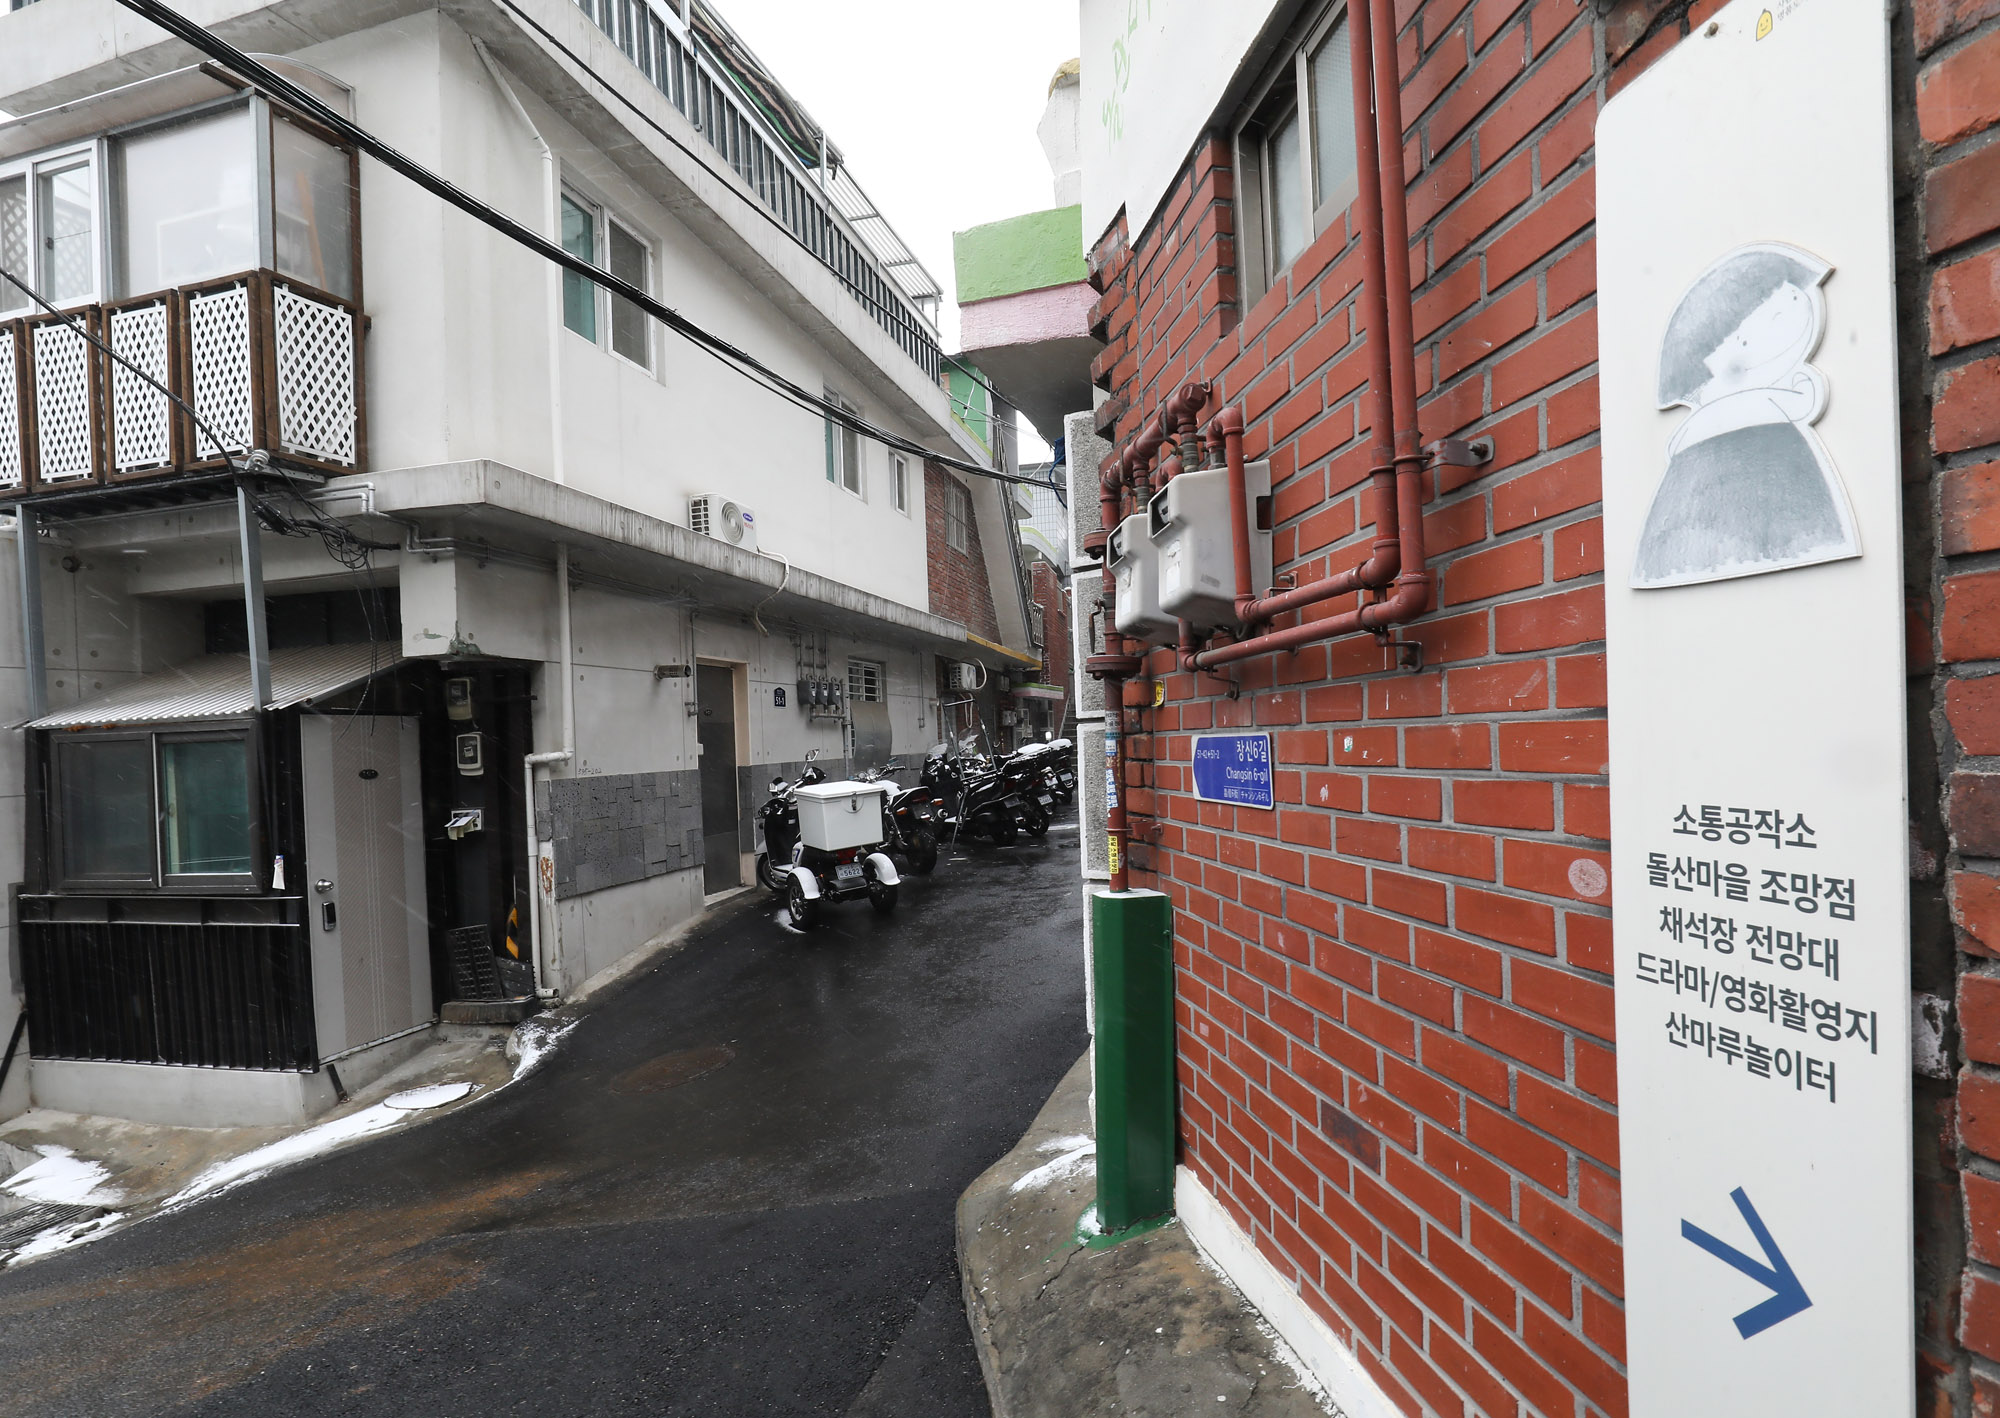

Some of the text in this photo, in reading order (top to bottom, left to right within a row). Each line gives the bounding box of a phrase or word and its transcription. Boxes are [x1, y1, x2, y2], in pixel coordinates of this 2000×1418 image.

[1225, 766, 1269, 784] Changsin 6-gil
[1236, 739, 1267, 762] 창신6길
[1673, 804, 1817, 850] 소통공작소
[1646, 852, 1855, 922] 돌산마을 조망점
[1659, 906, 1839, 982] 채석장 전망대
[1636, 952, 1878, 1055] 드라마/영화활영지
[1665, 1011, 1836, 1104] 산마루놀이터
